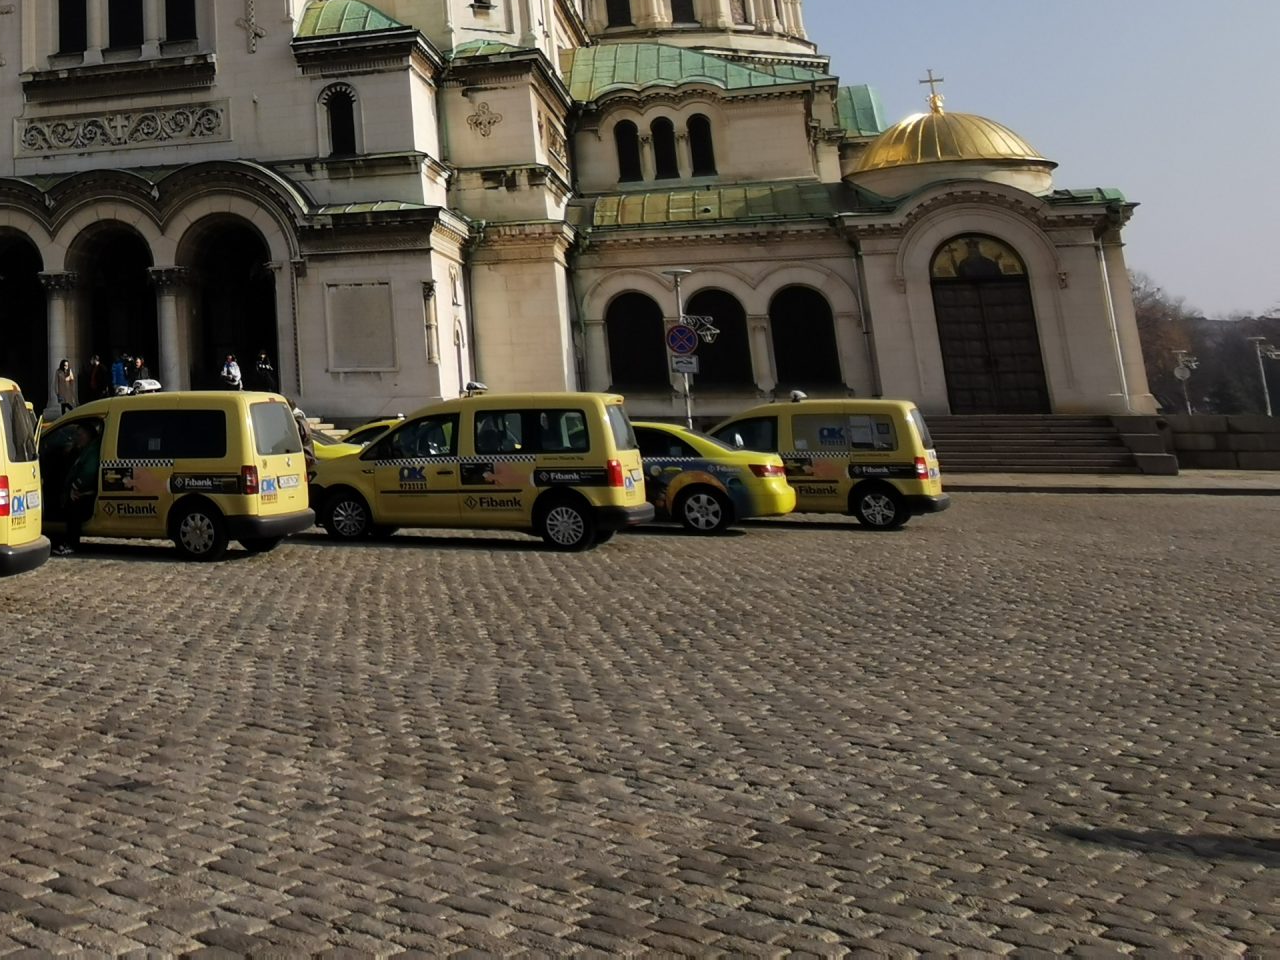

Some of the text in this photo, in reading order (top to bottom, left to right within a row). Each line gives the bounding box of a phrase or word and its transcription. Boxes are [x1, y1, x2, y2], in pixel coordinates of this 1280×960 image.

[550, 472, 580, 480] Fibank
[185, 477, 213, 487] Fibank
[800, 485, 838, 495] Fibank
[480, 496, 522, 508] Fibank
[116, 502, 157, 515] Fibank
